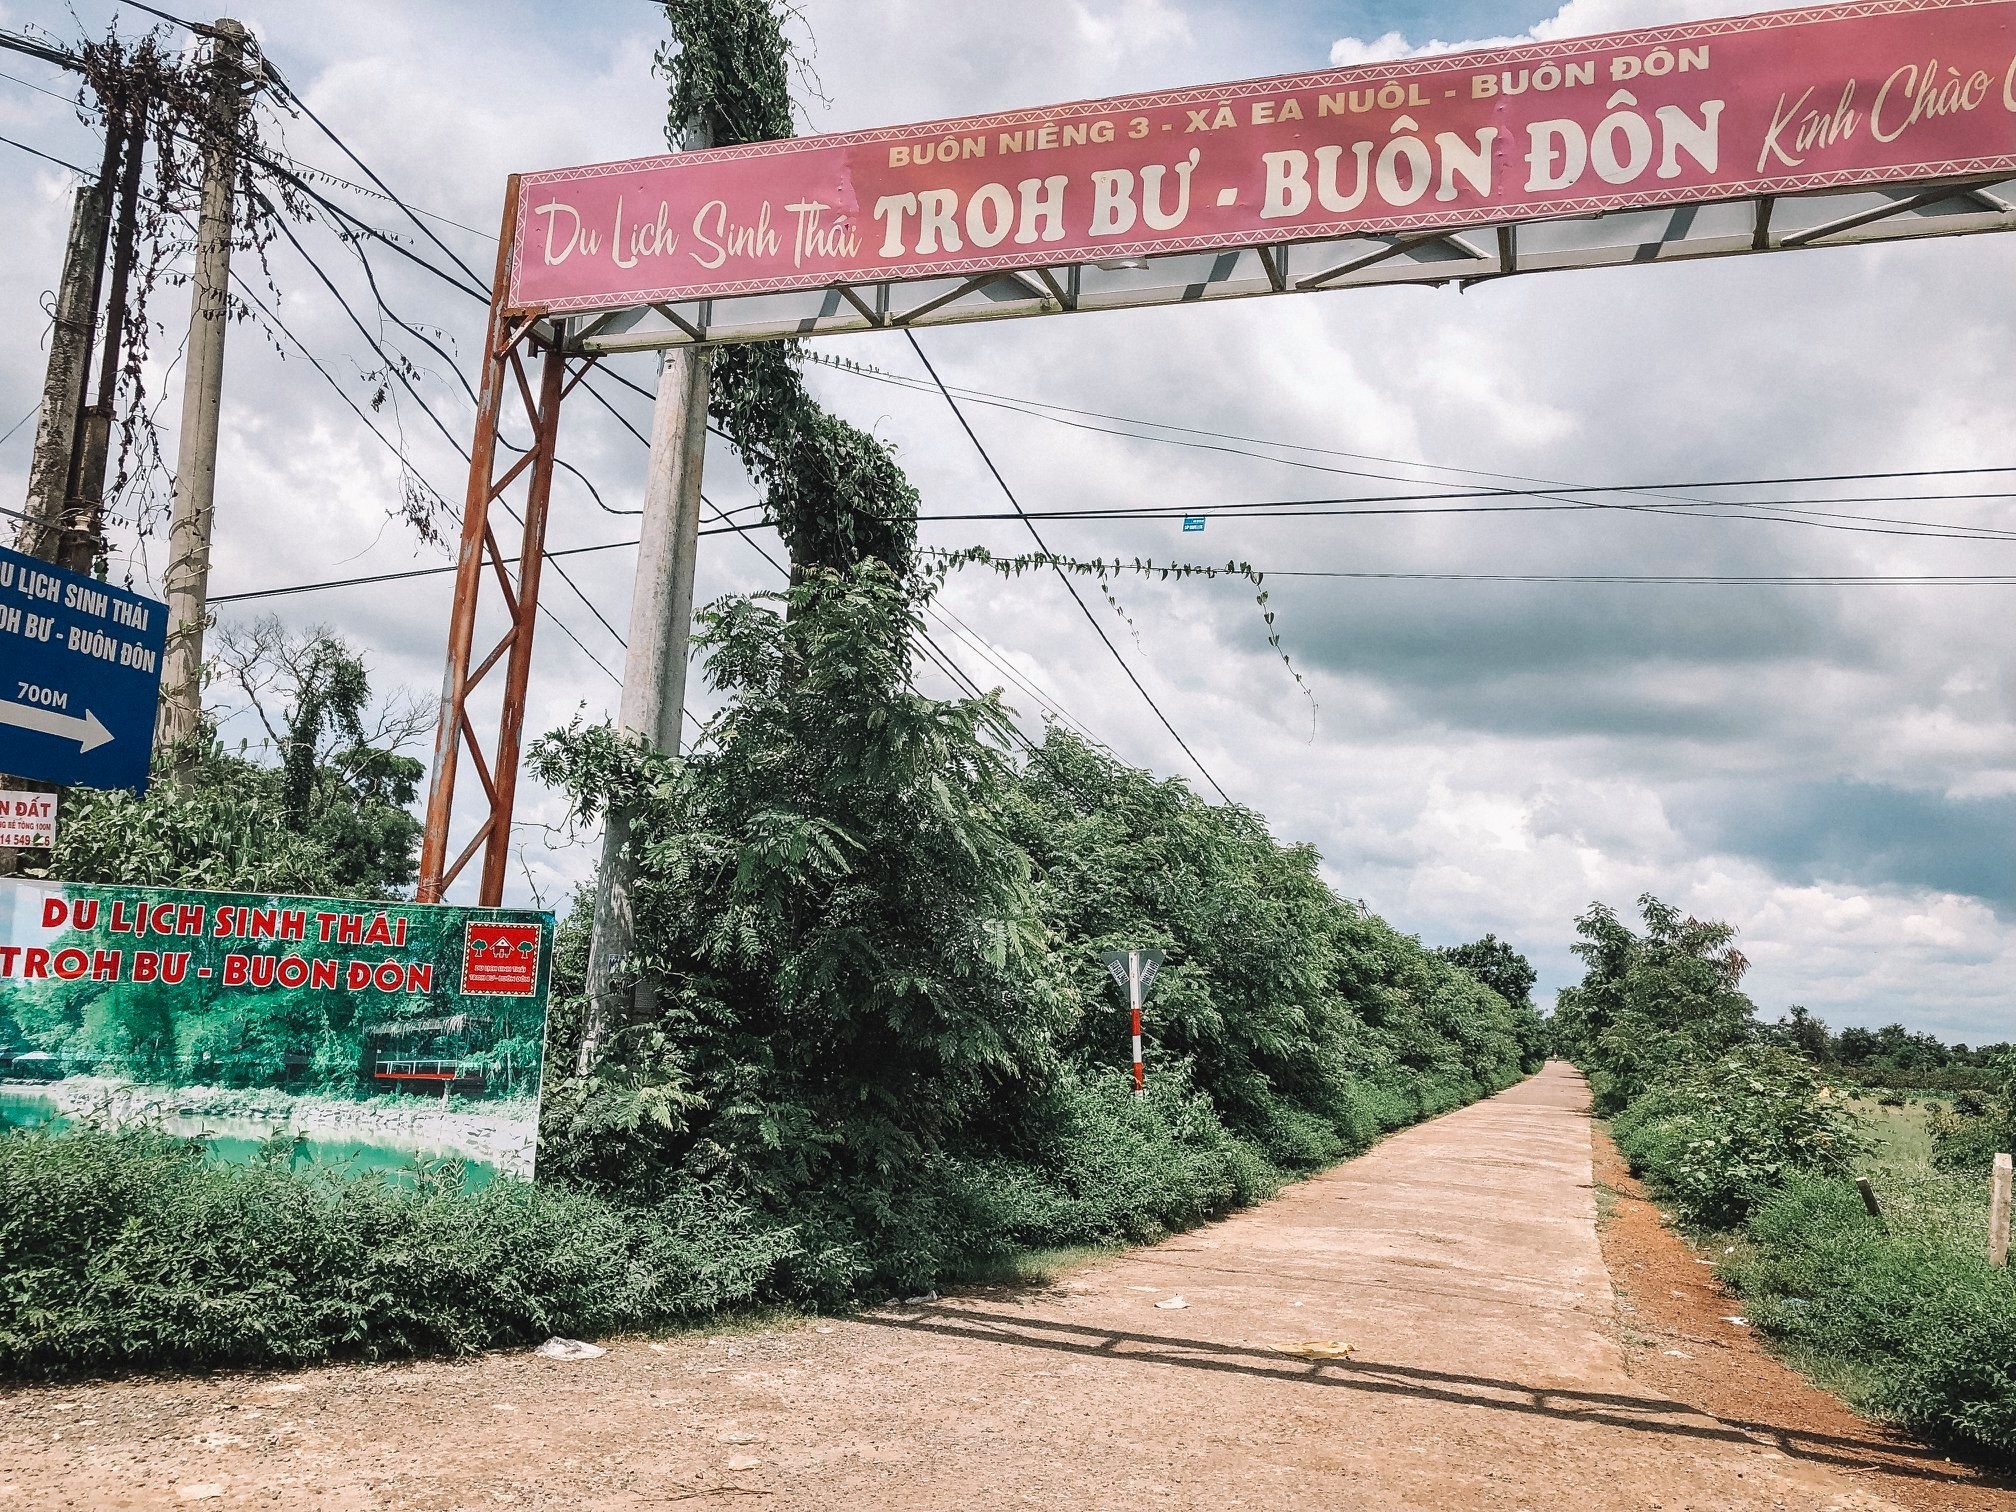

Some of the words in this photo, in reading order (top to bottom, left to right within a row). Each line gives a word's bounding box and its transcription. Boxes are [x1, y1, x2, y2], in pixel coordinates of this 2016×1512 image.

[888, 134, 986, 168] BUÔN
[998, 121, 1115, 155] NIÊNG
[1128, 117, 1150, 140] 3
[1184, 99, 1238, 133] XÃ
[1250, 98, 1304, 125] EA
[1318, 80, 1431, 117] NUÔL
[1472, 61, 1596, 99] BUÔN
[1609, 45, 1711, 83] ĐÔN
[1756, 78, 1862, 174] Kính
[1870, 58, 1995, 143] Chào
[873, 174, 1069, 259] TROH
[1088, 148, 1201, 237] BƯ
[1260, 115, 1498, 220] BUÔN
[1525, 89, 1726, 194] ĐÔN
[535, 196, 603, 267] Du
[612, 195, 679, 269] Lịch
[689, 200, 782, 270] Sinh
[784, 197, 863, 269] Thái
[0, 561, 15, 588] U
[18, 566, 61, 602] LỊCH
[64, 583, 109, 618] SINH
[113, 599, 149, 631] THÁI
[0, 604, 22, 634] OH
[25, 612, 55, 643] BƯ
[68, 626, 117, 662] BUÔN
[120, 642, 156, 674] ĐÔN
[17, 681, 69, 710] 700M
[15, 796, 51, 818] ĐẤT
[42, 898, 100, 931] DU
[110, 901, 206, 938] LỊCH
[214, 906, 306, 940] SINH
[317, 912, 408, 947] THÁI
[0, 946, 122, 982] TROH
[132, 951, 192, 984] BƯ
[223, 953, 339, 990] BUÔN
[347, 958, 433, 993] ĐÔN
